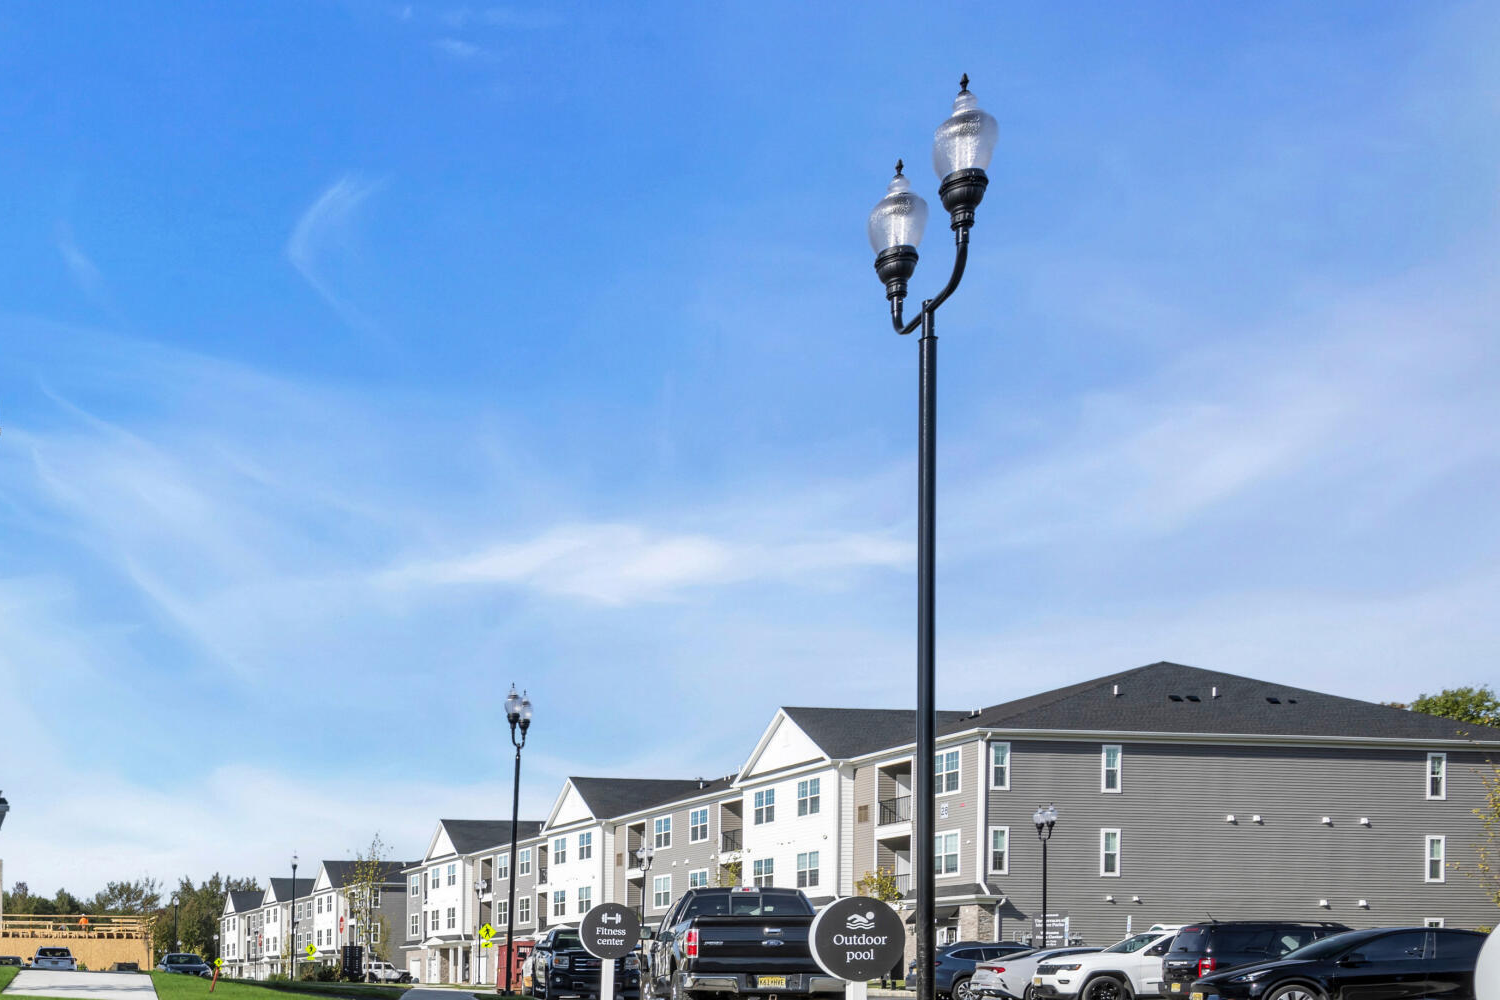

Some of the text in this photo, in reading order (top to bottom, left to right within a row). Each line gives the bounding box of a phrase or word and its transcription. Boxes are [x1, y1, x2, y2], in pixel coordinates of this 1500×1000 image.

[595, 926, 627, 936] Fitness
[596, 938, 625, 946] center
[833, 933, 888, 946] Outdoor
[846, 948, 874, 963] pool
